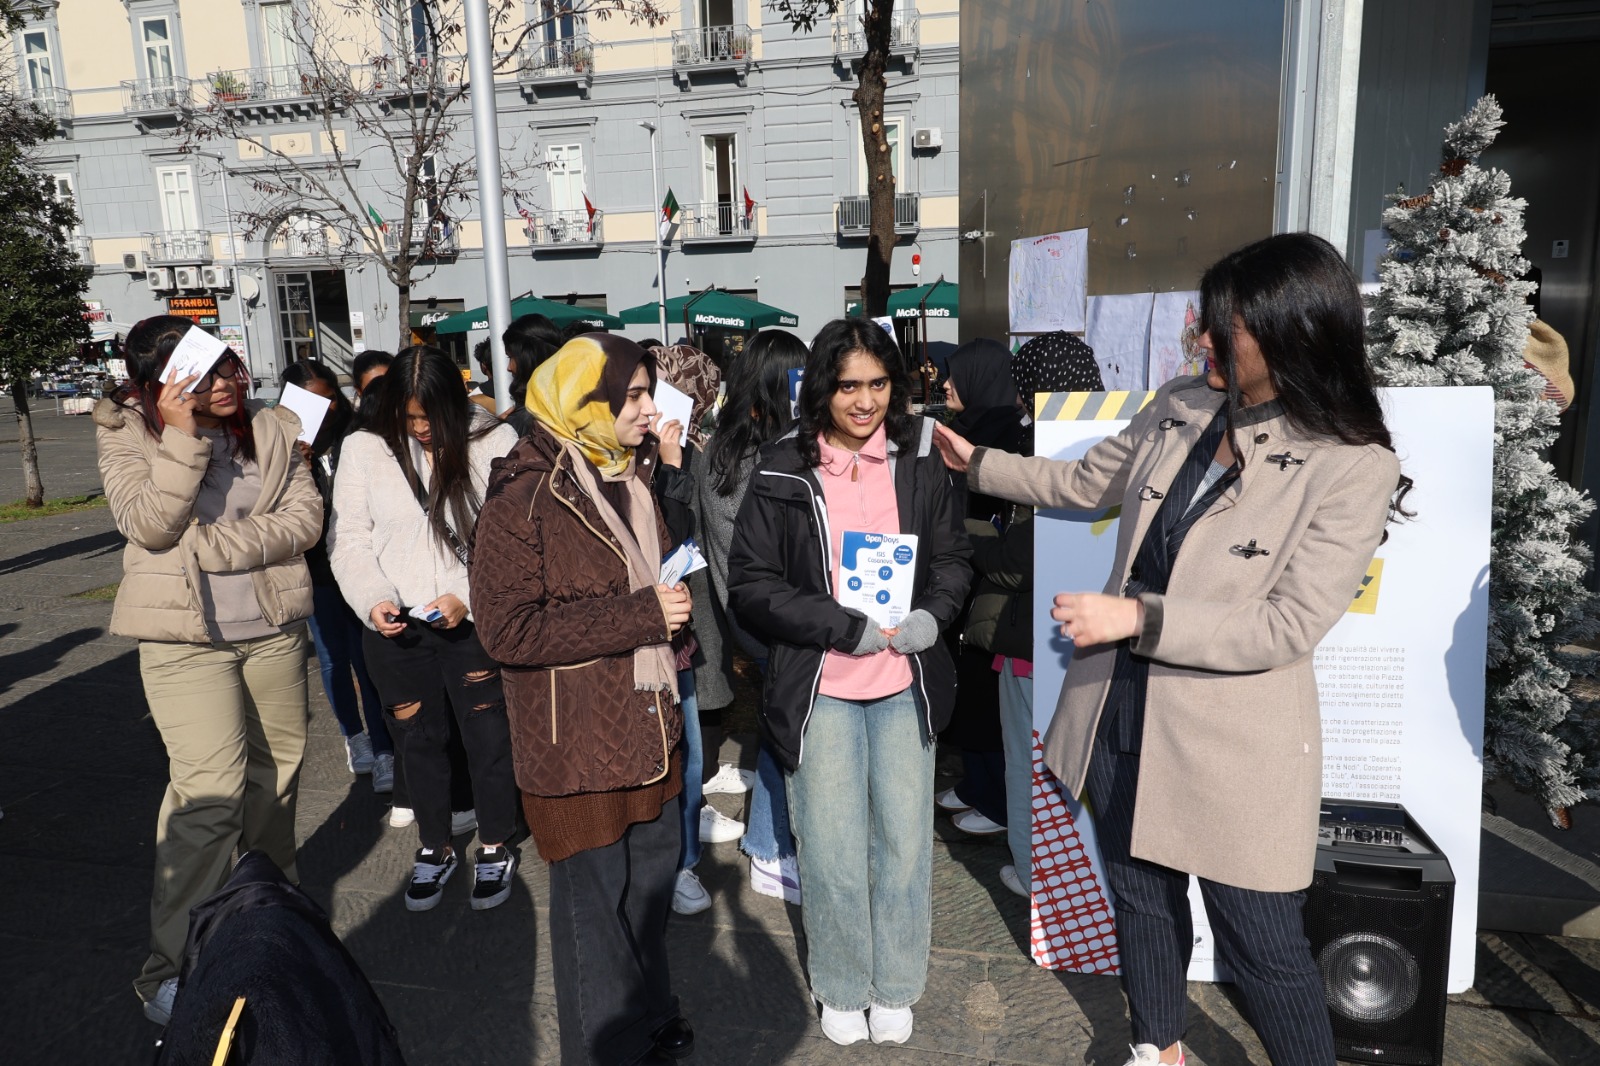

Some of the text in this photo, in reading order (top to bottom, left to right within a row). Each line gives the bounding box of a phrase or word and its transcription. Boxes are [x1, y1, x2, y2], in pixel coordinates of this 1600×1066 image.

[170, 299, 214, 307] ISTANBUL
[421, 312, 449, 326] McCaf
[695, 314, 744, 326] McDonald's
[865, 534, 899, 544] Open Days
